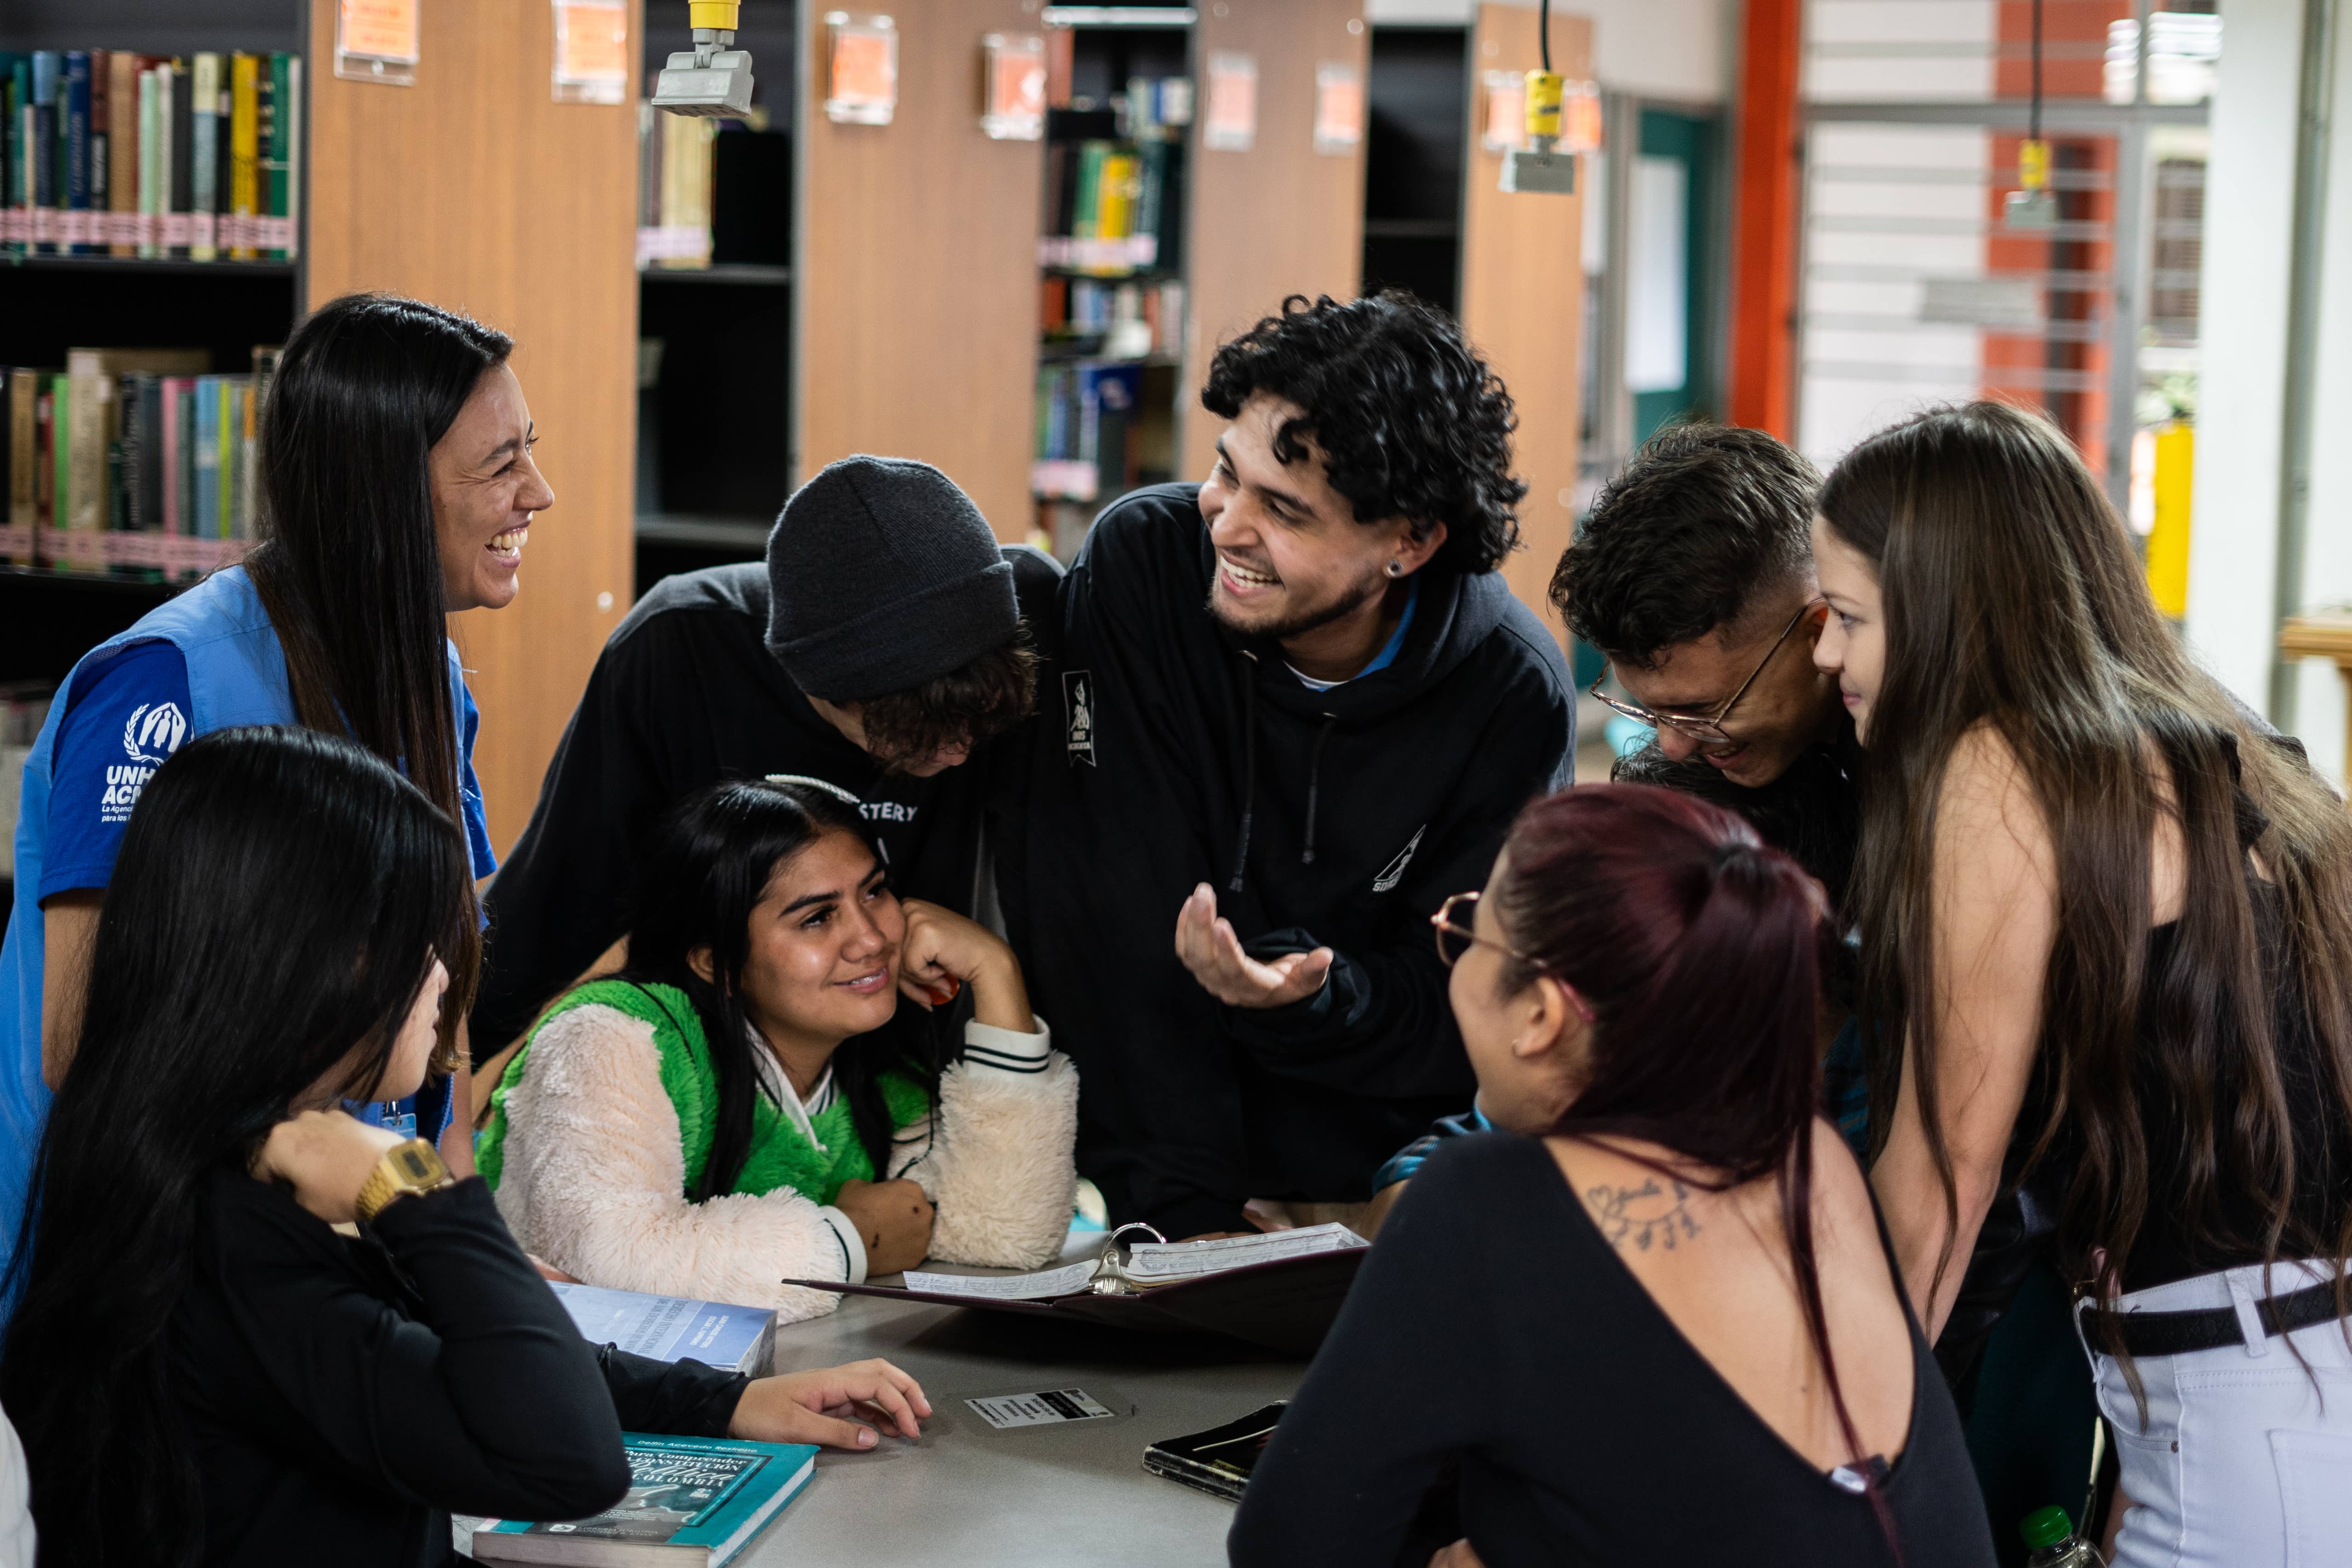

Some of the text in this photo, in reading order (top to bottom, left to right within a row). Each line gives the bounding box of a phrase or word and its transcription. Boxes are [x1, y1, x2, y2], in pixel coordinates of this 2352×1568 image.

[663, 1300, 688, 1321] DERECHO
[636, 1458, 741, 1471] CONSTITUCIÓN
[658, 1452, 747, 1464] Comprender
[632, 1474, 723, 1487] COLOMBIA
